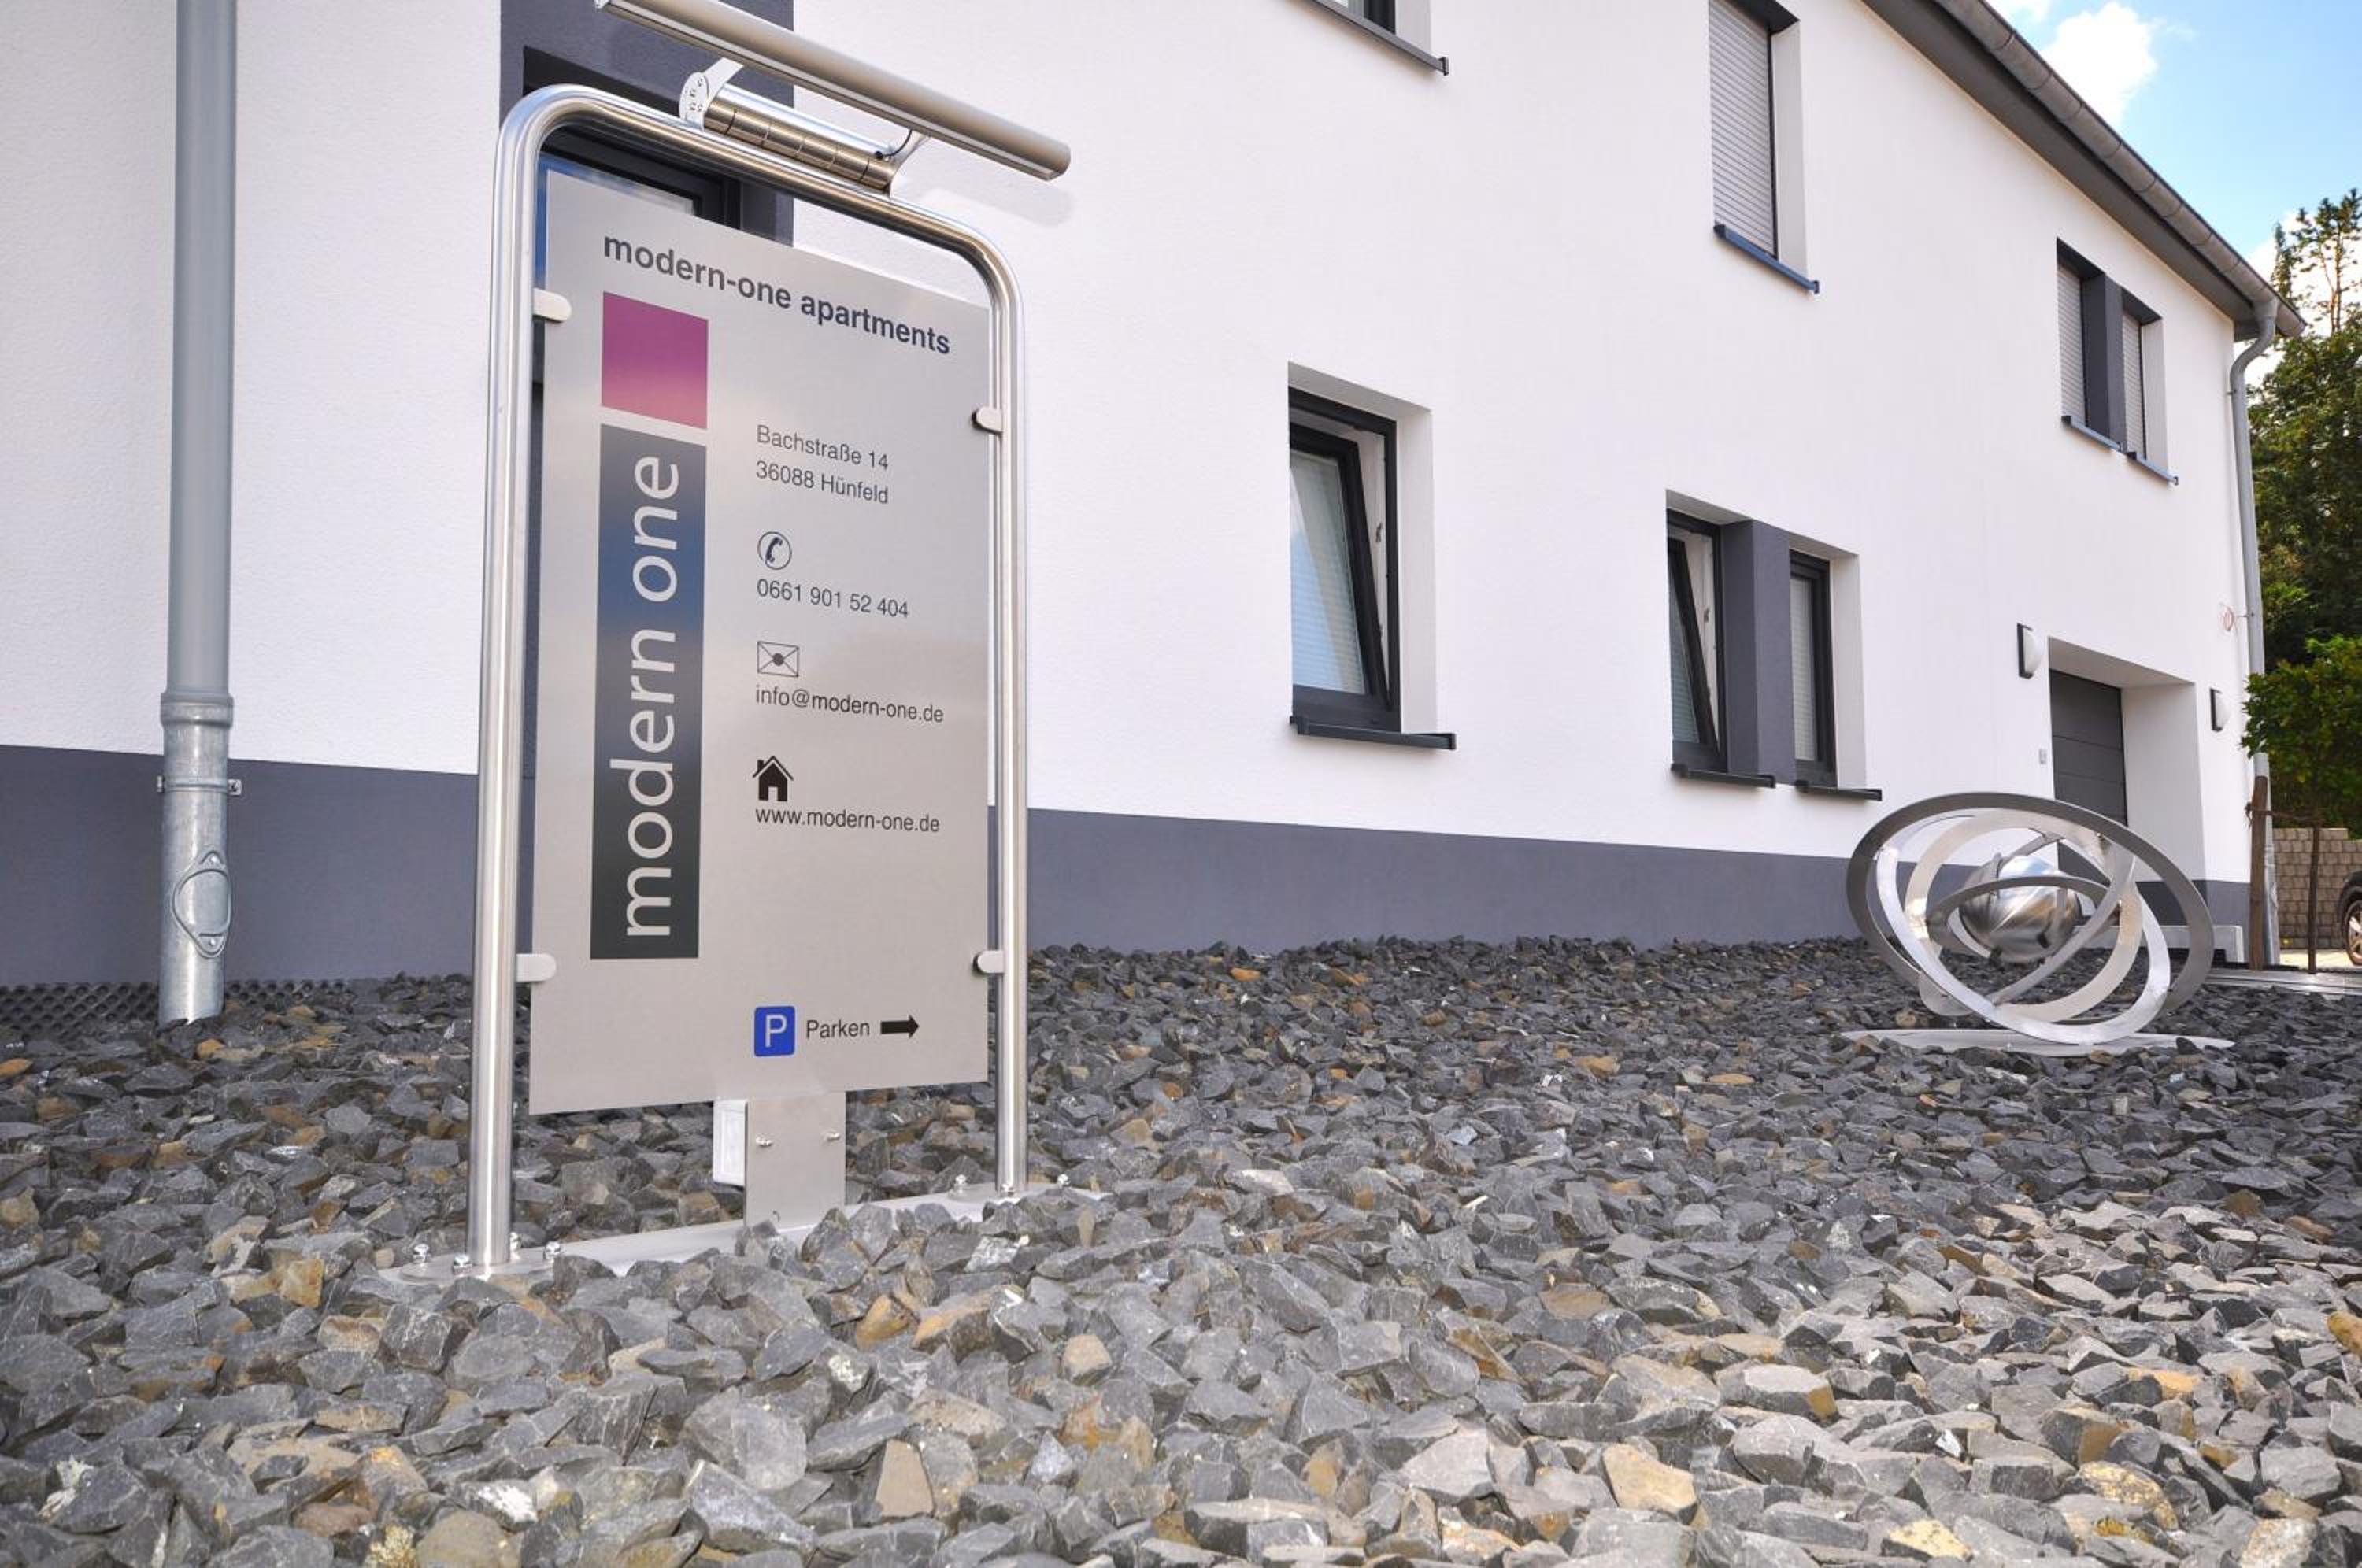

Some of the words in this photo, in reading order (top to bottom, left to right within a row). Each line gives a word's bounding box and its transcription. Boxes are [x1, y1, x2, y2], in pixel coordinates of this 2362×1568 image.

[603, 236, 791, 309] modern-one
[801, 291, 950, 355] apartments
[756, 424, 862, 465] Bachstraße
[868, 450, 889, 471] 14
[756, 460, 815, 489] 36088
[820, 474, 889, 504] Hünfeld
[633, 456, 679, 602] one
[757, 579, 802, 602] 0661
[809, 587, 841, 608] 901
[850, 594, 872, 613] 52
[876, 598, 909, 618] 404
[756, 684, 944, 723] info@modern-one.de
[610, 629, 676, 936] modern
[755, 808, 940, 833] www.modern-one.de
[765, 1015, 787, 1048] P
[805, 1019, 870, 1040] Parken
